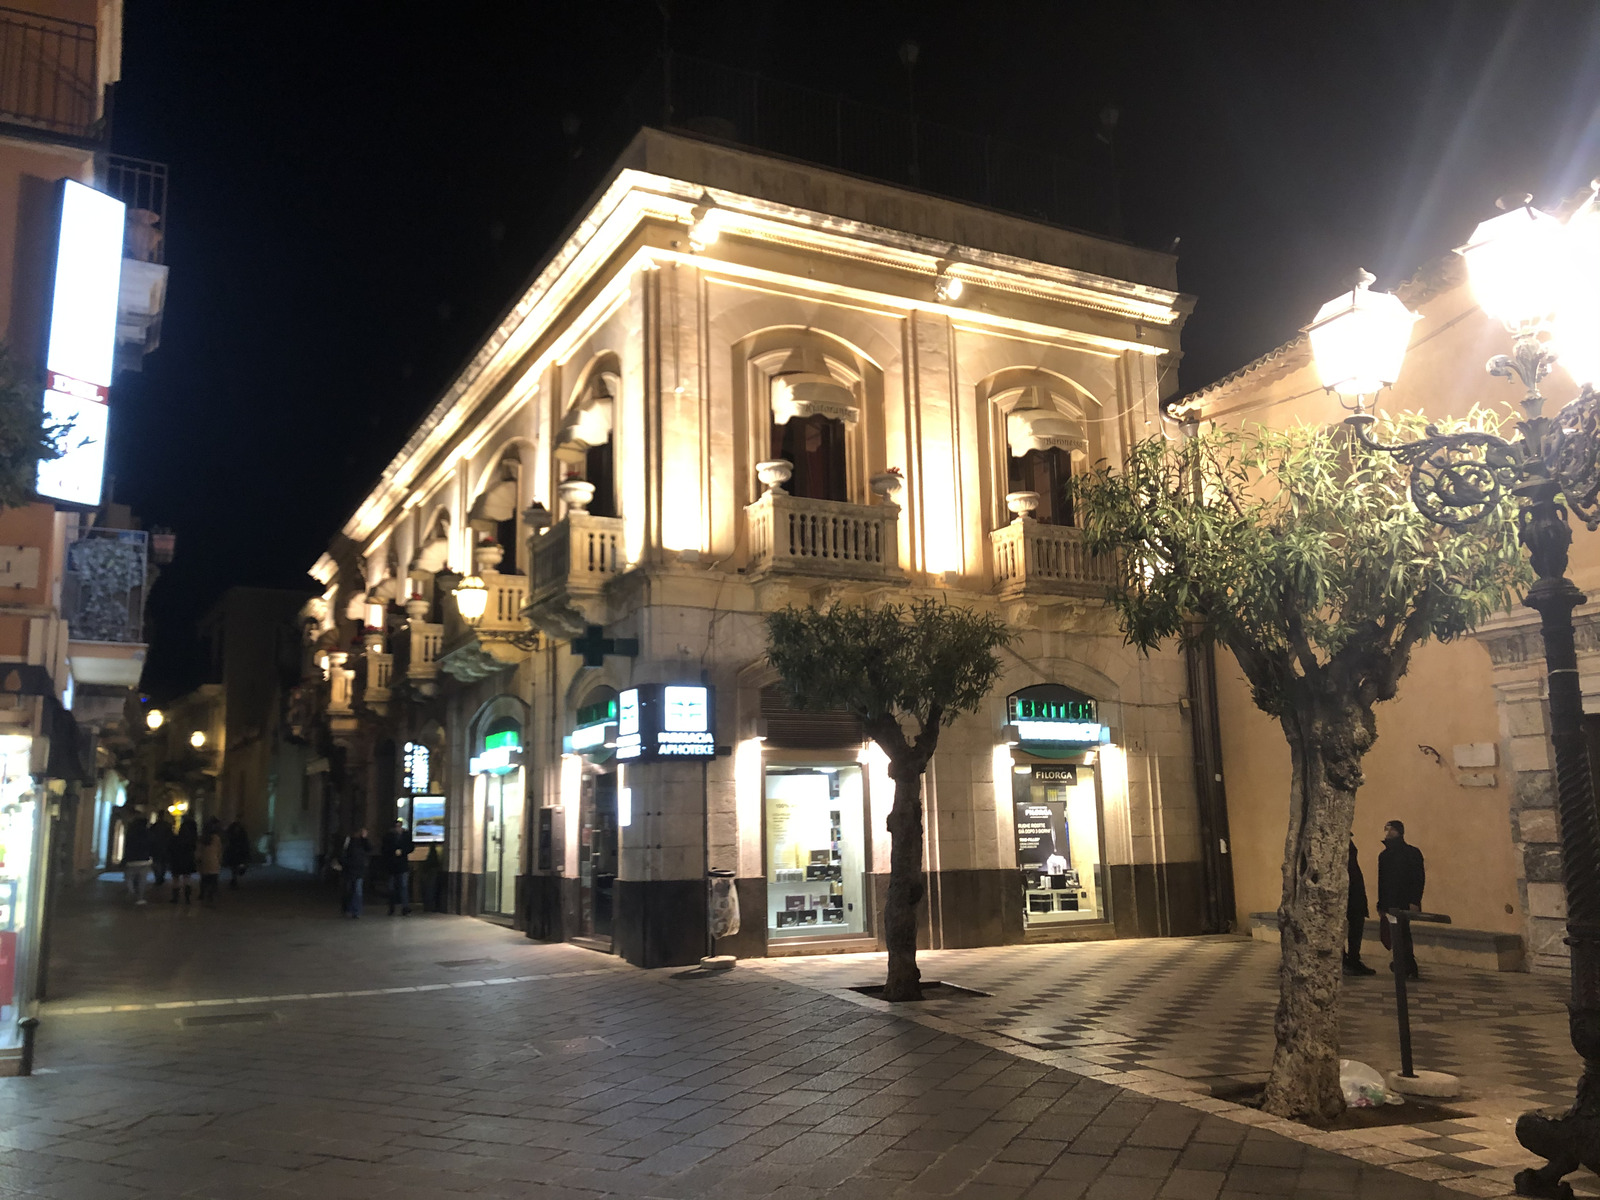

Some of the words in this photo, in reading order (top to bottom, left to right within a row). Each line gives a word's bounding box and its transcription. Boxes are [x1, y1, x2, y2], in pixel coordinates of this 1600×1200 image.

[1020, 700, 1093, 719] BRITISH
[657, 744, 715, 755] APHOTEKE
[1035, 771, 1073, 780] FILORGA
